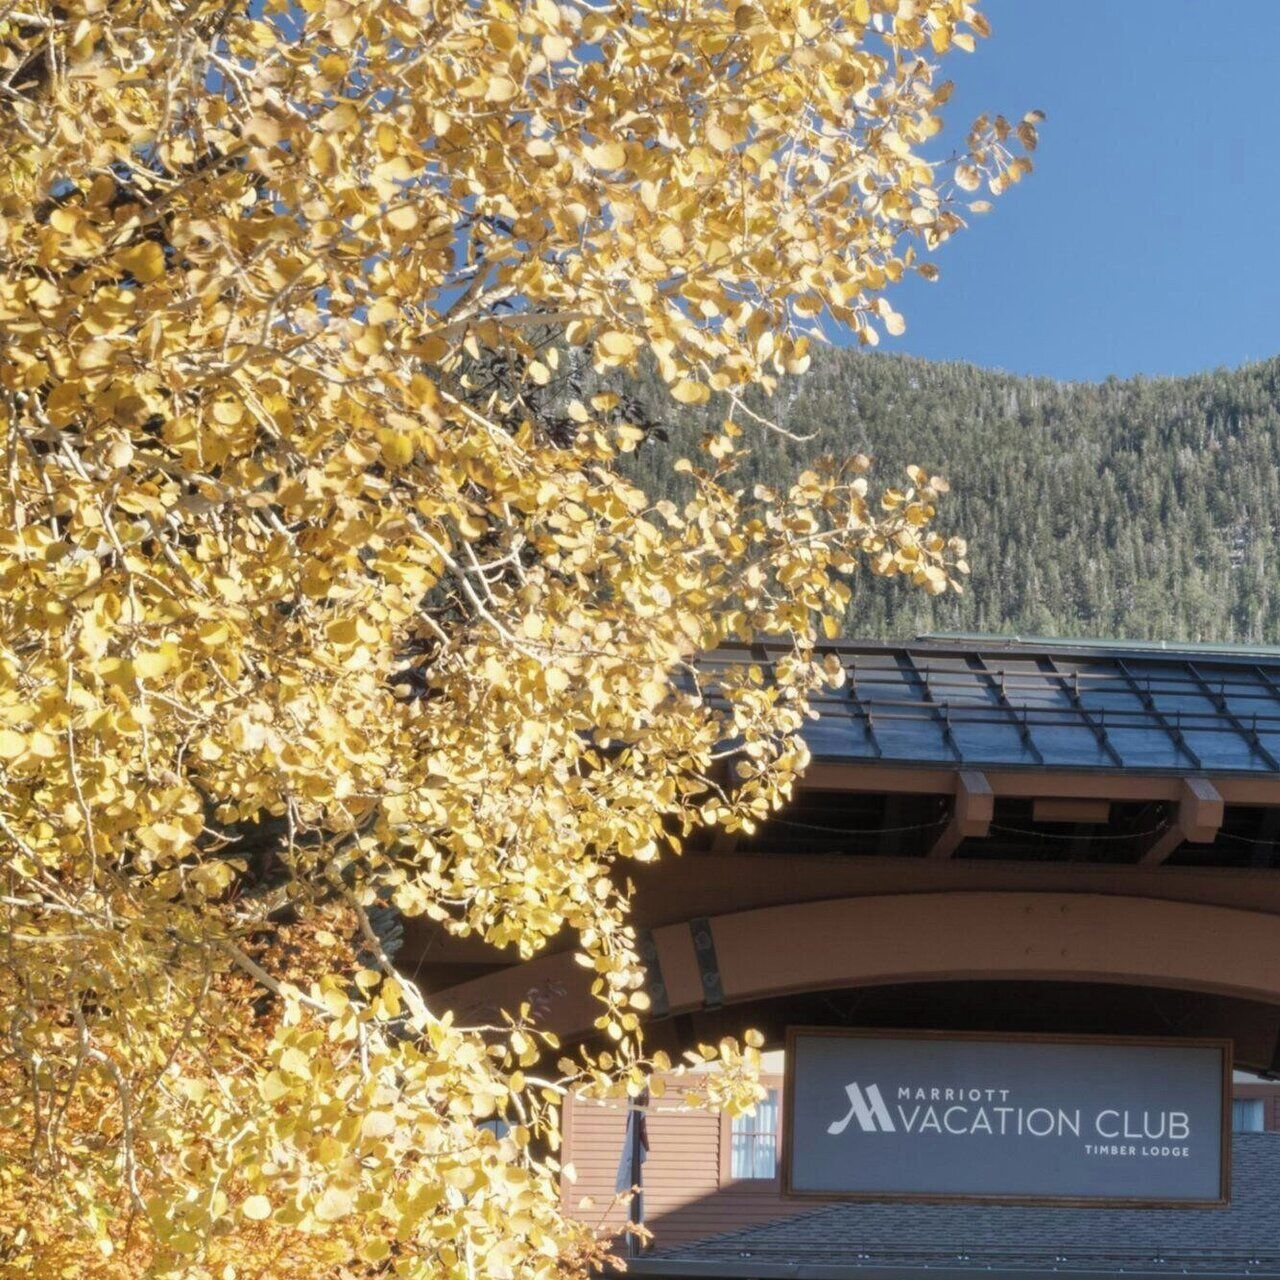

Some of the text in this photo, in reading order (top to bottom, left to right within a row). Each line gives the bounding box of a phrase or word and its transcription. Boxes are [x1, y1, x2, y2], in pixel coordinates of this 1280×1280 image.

[899, 1087, 1010, 1102] MARRIOTT
[898, 1105, 1190, 1139] VACATION CLUB
[1085, 1144, 1190, 1157] TIMBER LODGE
